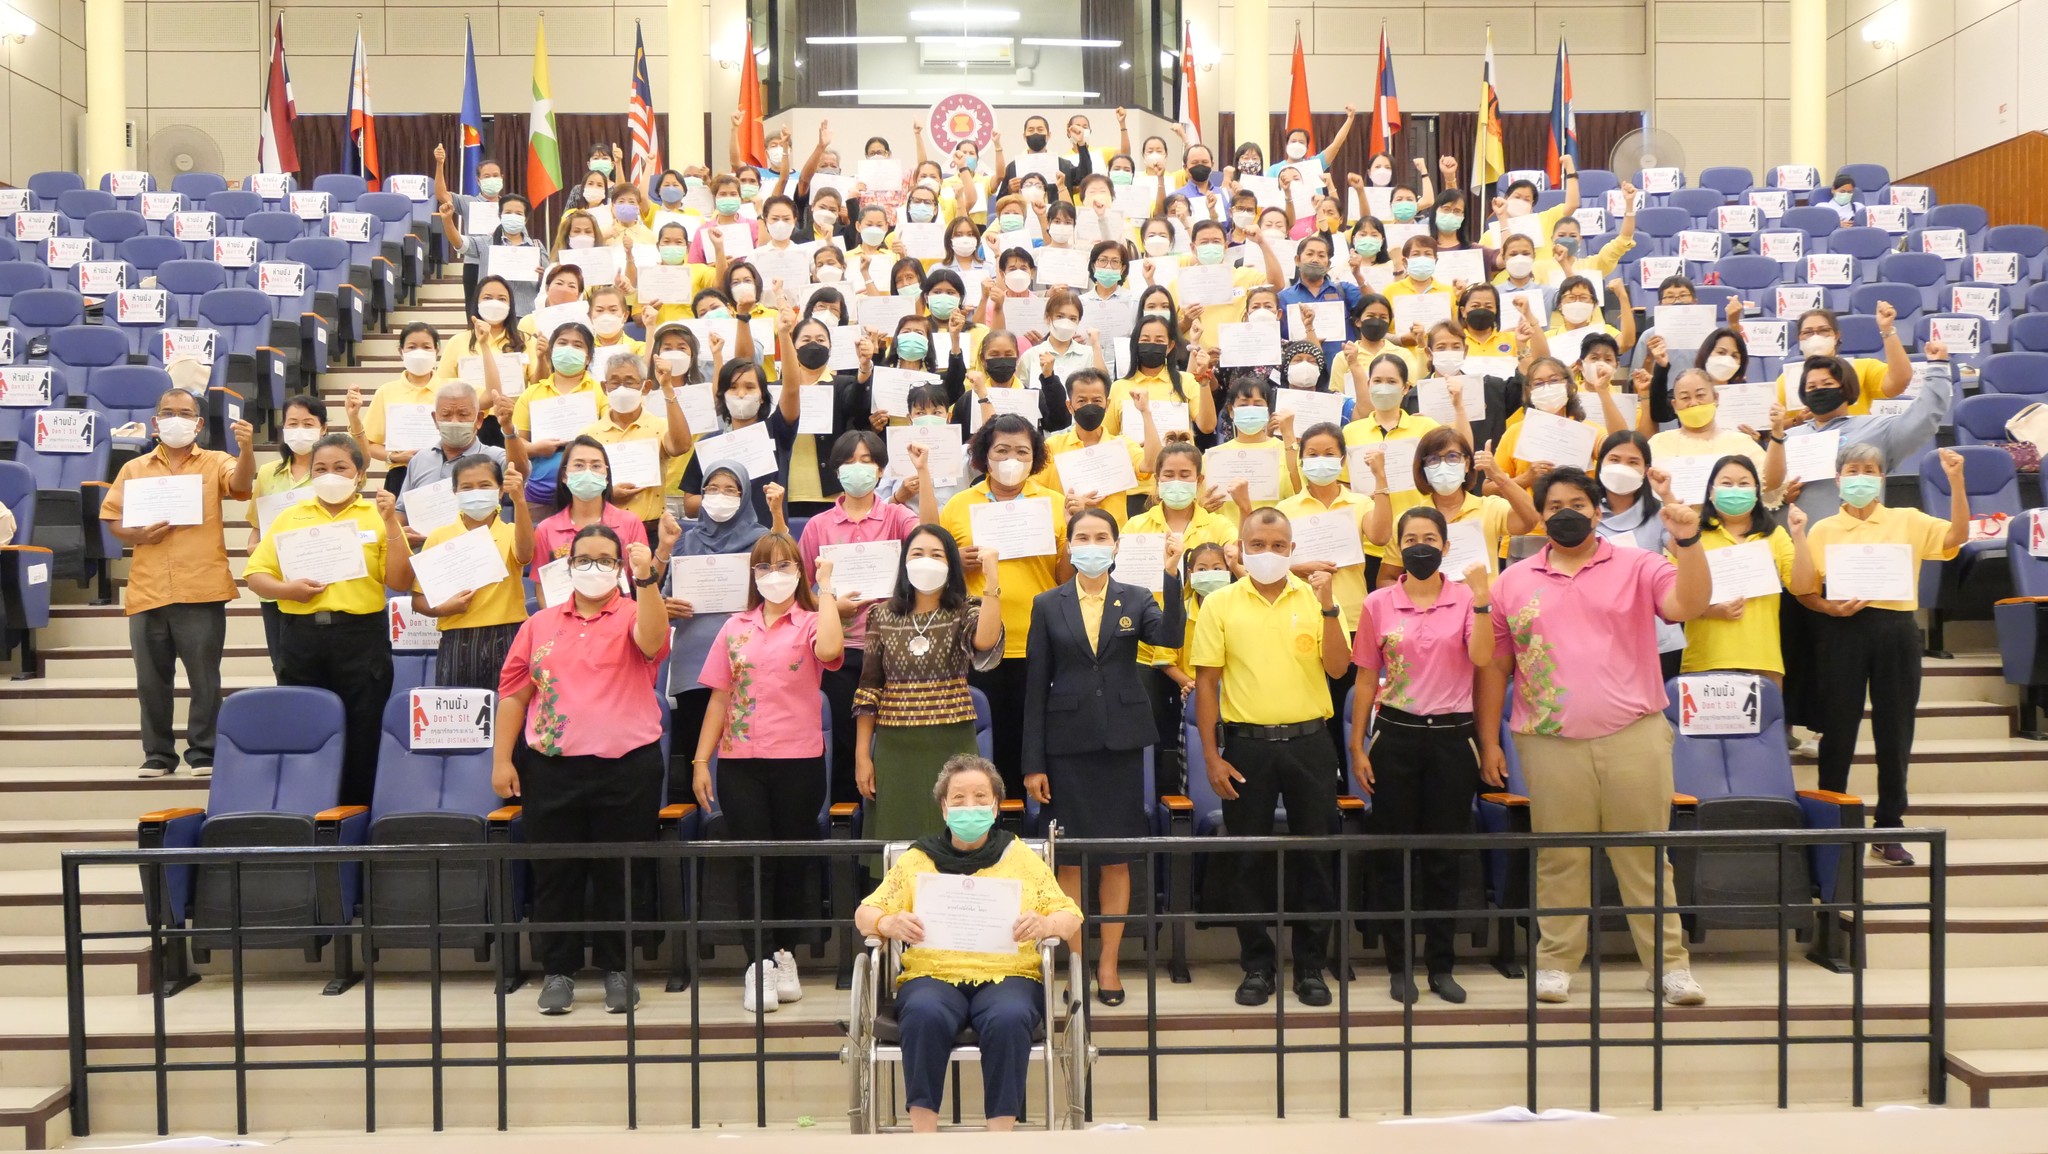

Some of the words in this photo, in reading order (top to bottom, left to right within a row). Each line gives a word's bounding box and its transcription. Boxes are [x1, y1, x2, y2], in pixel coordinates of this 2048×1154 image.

[132, 293, 151, 301] ห้ามนั่ง
[179, 332, 199, 342] ห้ามนั่ง
[13, 372, 34, 382] ห้ามนั่ง
[54, 416, 76, 425] ห้ามนั่ง
[1704, 681, 1735, 696] ห้ามนั่ง
[436, 694, 468, 710] ห้ามนั่ง
